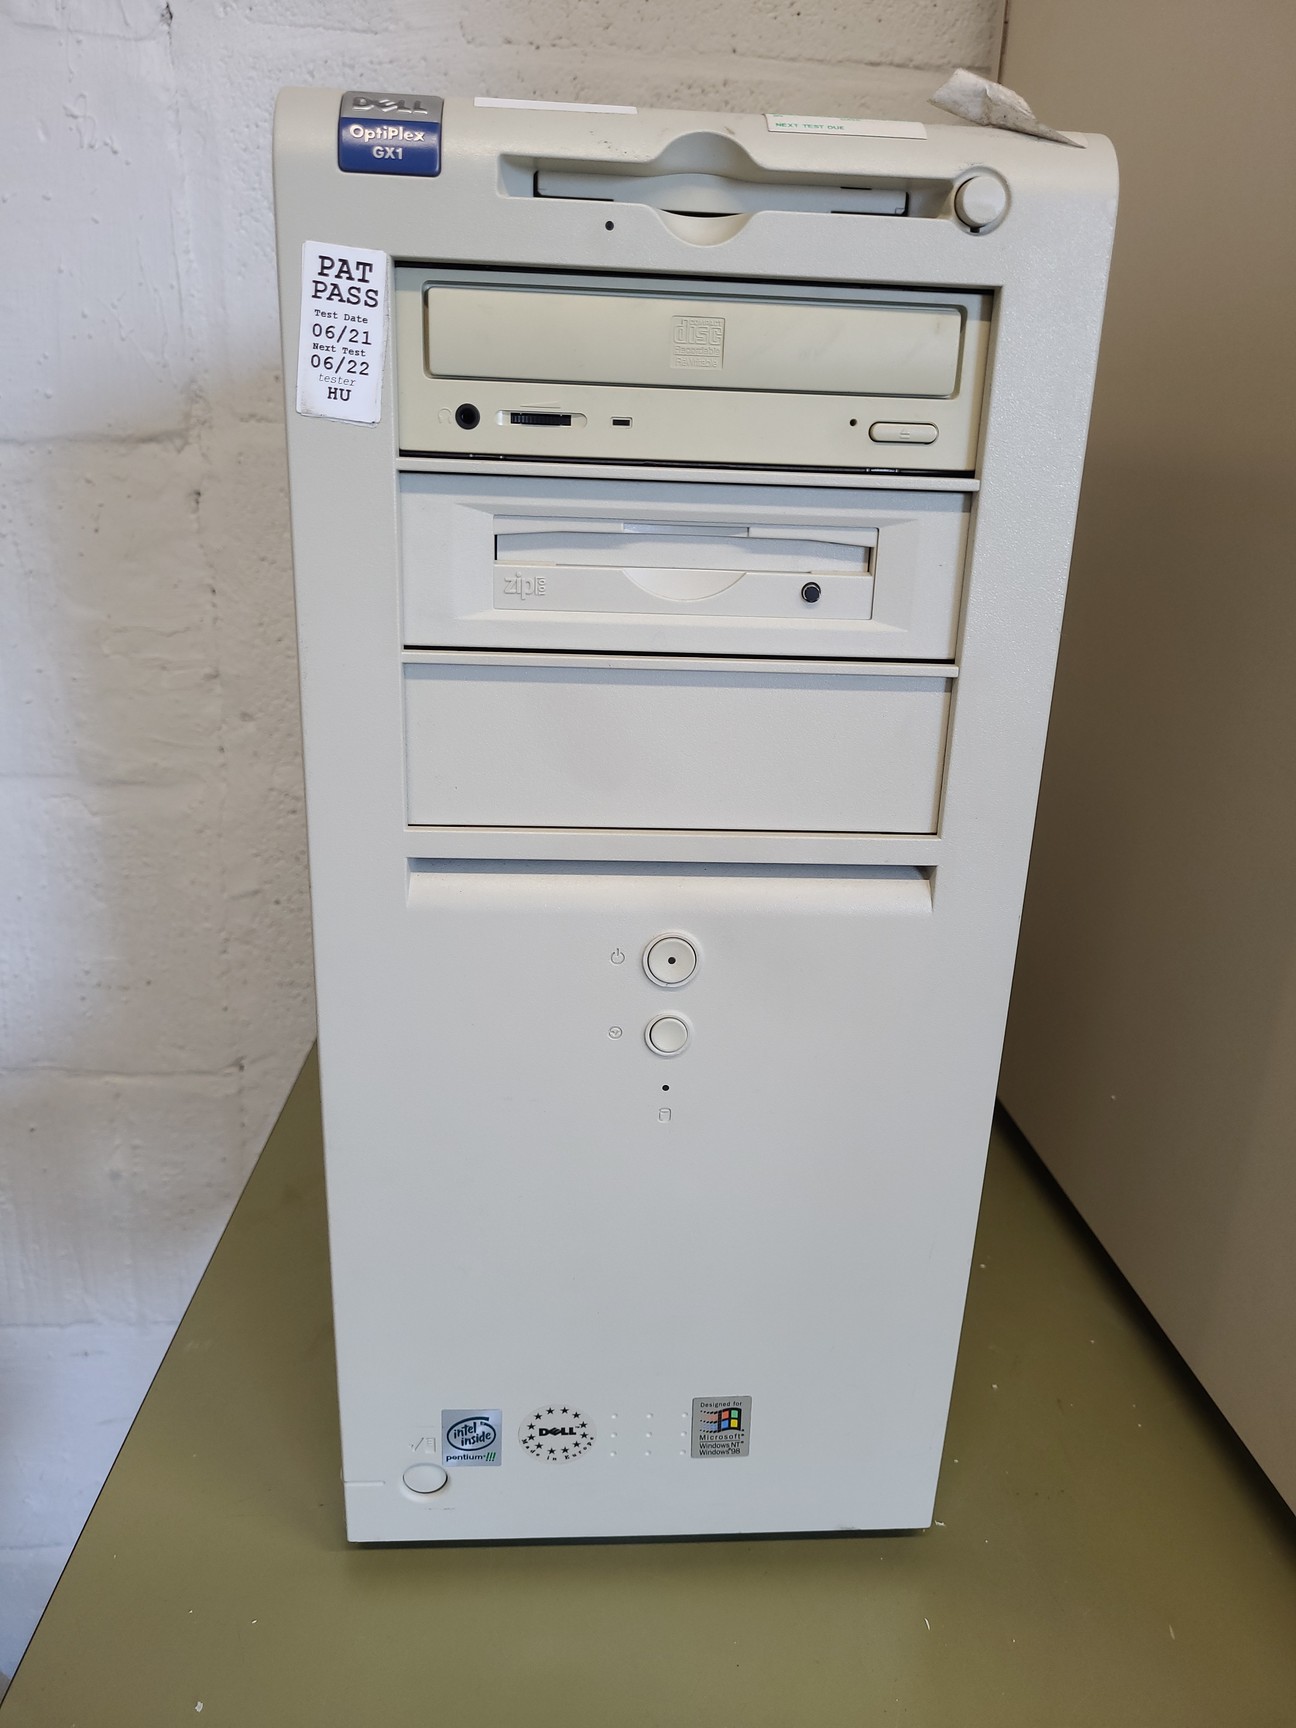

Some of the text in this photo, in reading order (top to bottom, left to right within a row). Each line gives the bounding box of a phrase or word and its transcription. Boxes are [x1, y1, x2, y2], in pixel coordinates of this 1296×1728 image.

[352, 97, 428, 114] DELL
[349, 124, 425, 142] OptiPlex
[372, 146, 403, 160] GX1
[317, 255, 373, 283] PAT
[311, 279, 379, 308] PASS
[314, 309, 368, 324] Test Date
[312, 323, 372, 345] 06/21
[312, 343, 366, 357] Next Test
[310, 354, 370, 376] 06/22
[318, 374, 356, 387] tester
[327, 386, 352, 402] HU
[504, 571, 535, 600] zip
[453, 1421, 477, 1440] intel
[538, 1427, 577, 1437] DELL
[699, 1433, 741, 1441] Microsoft
[460, 1431, 492, 1447] inside
[699, 1448, 730, 1456] Windows
